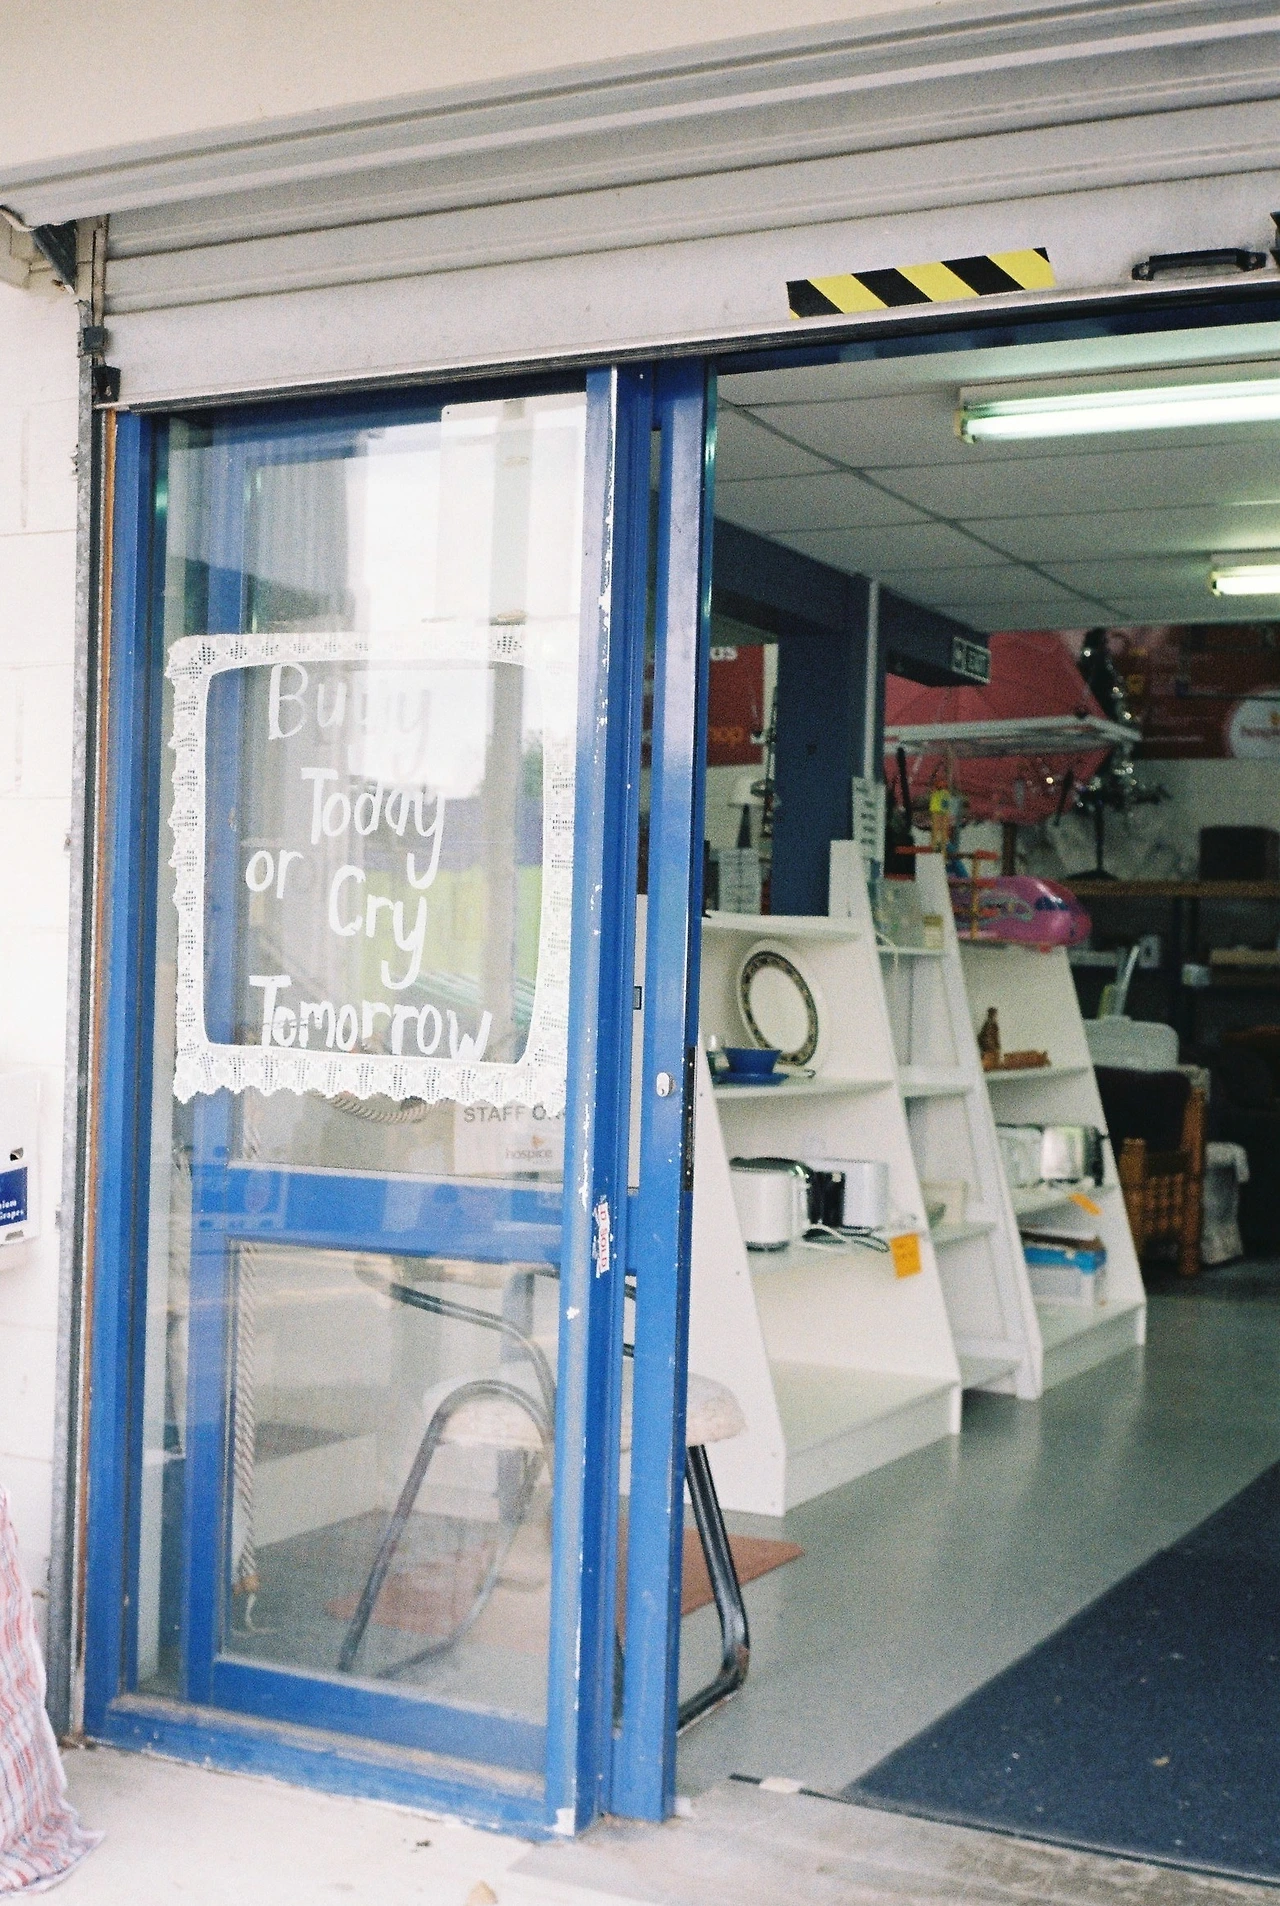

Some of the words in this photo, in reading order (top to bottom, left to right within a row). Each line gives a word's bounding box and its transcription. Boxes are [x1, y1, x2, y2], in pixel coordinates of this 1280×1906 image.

[301, 768, 446, 890] Today
[246, 850, 304, 899] or
[329, 865, 427, 990] Cry
[249, 975, 492, 1061] Tomorrow
[463, 1105, 526, 1122] STAFF
